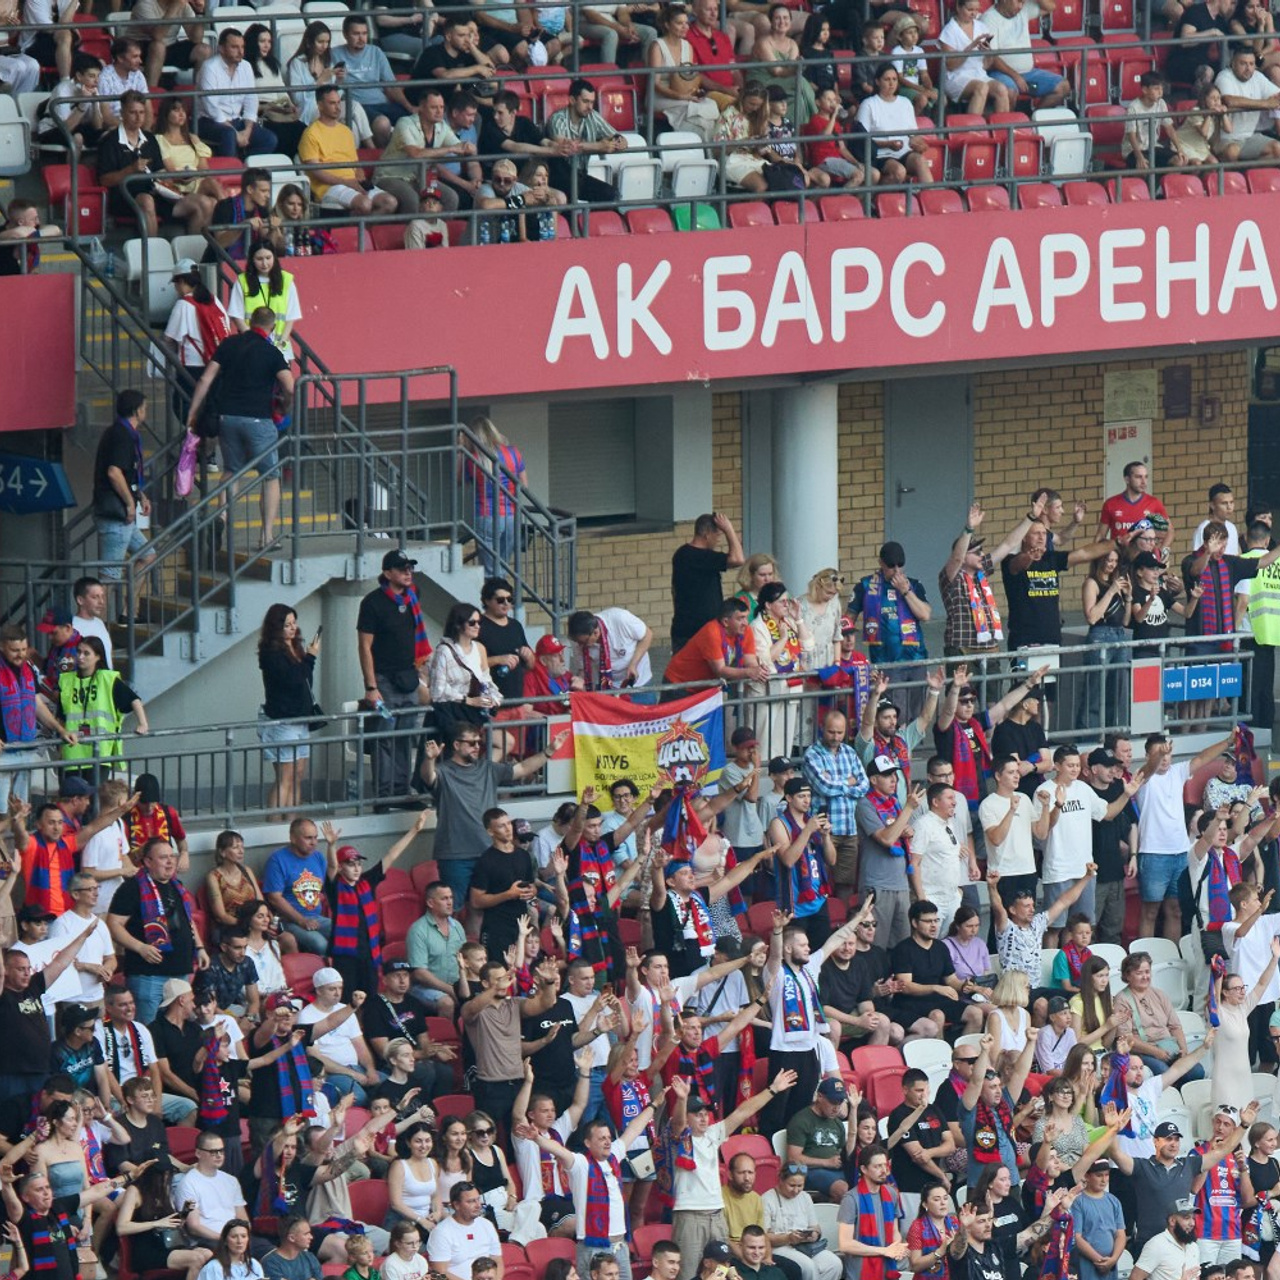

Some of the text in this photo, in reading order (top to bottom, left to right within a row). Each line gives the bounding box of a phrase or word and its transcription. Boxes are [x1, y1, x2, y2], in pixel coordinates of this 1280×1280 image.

[546, 220, 1277, 363] АК БАРС АРЕНА
[1191, 678, 1212, 688] D134
[596, 755, 629, 770] КЛУБ
[658, 740, 706, 768] ЦСКА
